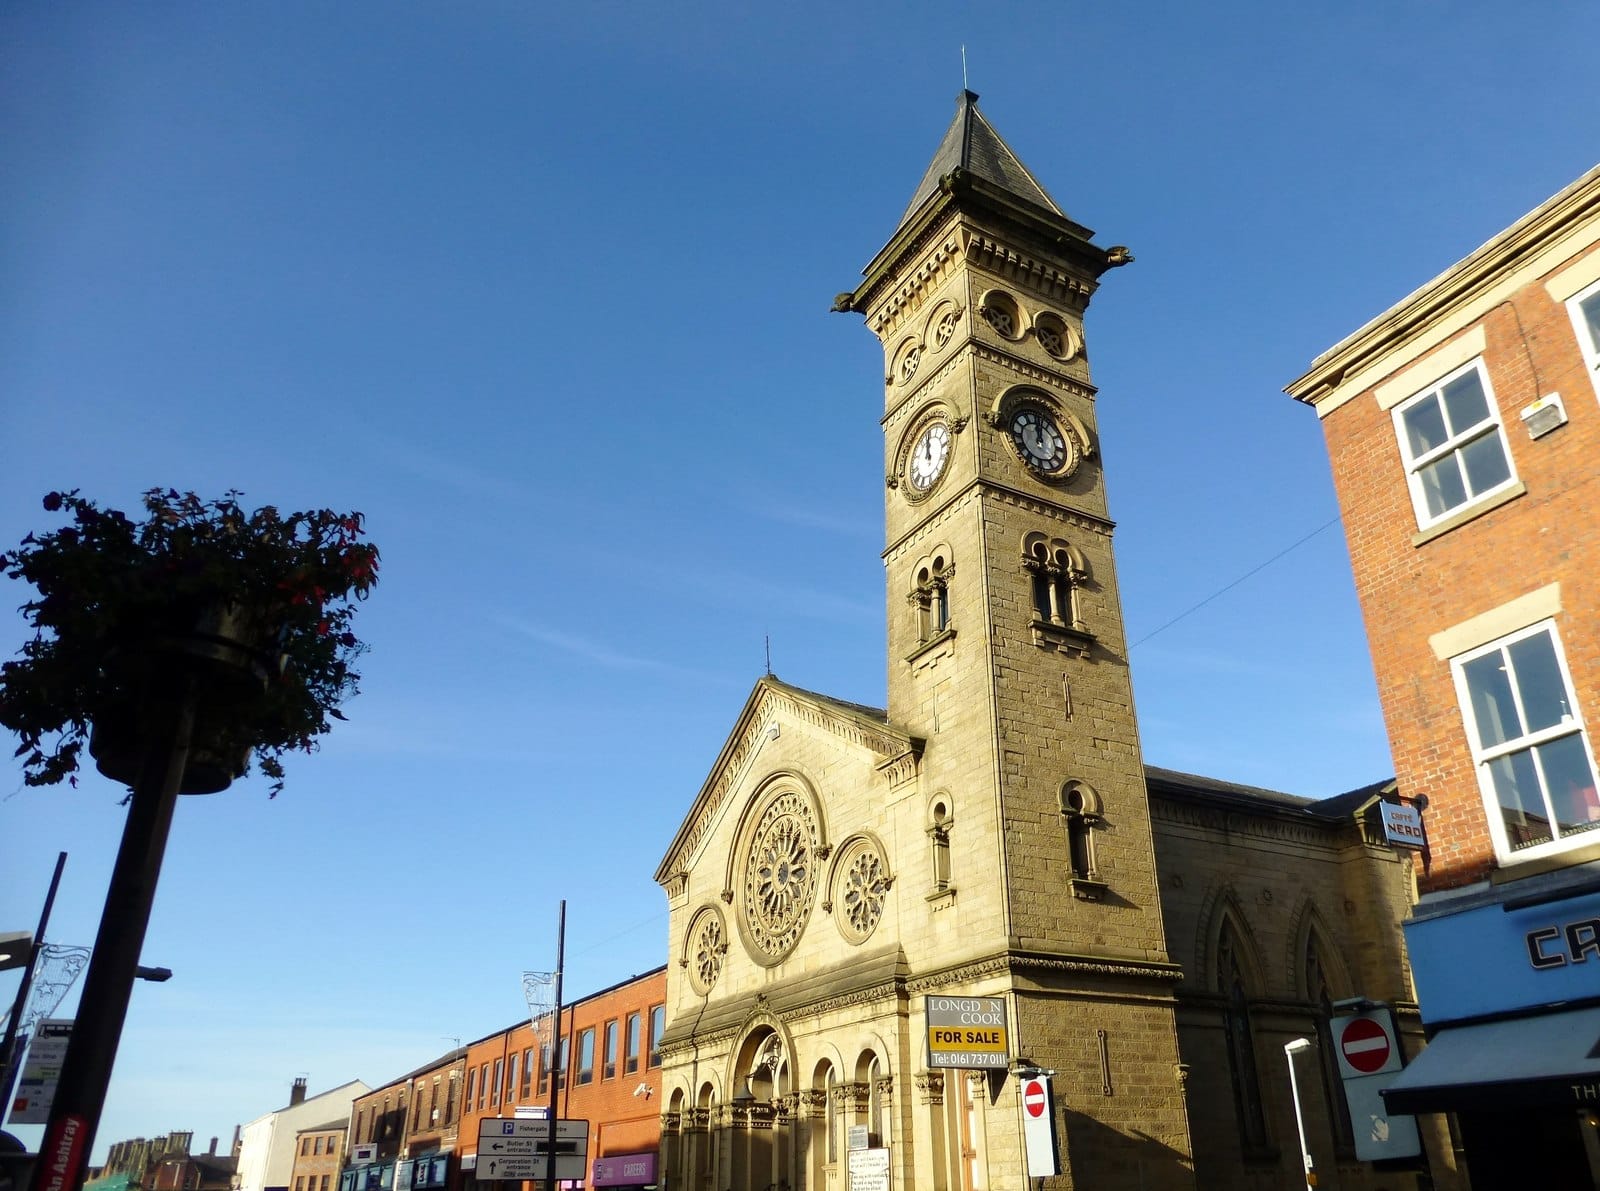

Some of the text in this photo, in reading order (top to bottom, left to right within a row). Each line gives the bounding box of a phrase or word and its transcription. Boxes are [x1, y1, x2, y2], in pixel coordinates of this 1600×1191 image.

[1387, 823, 1422, 838] NERO
[931, 999, 1002, 1013] LONGDN
[960, 1012, 1002, 1025] COOK
[935, 1031, 1000, 1044] FOR SALE
[932, 1053, 1006, 1066] Tel: 0161 737 0111
[1570, 1083, 1600, 1101] TH
[52, 1117, 80, 1174] Ashtray
[623, 1162, 647, 1177] CAREERS
